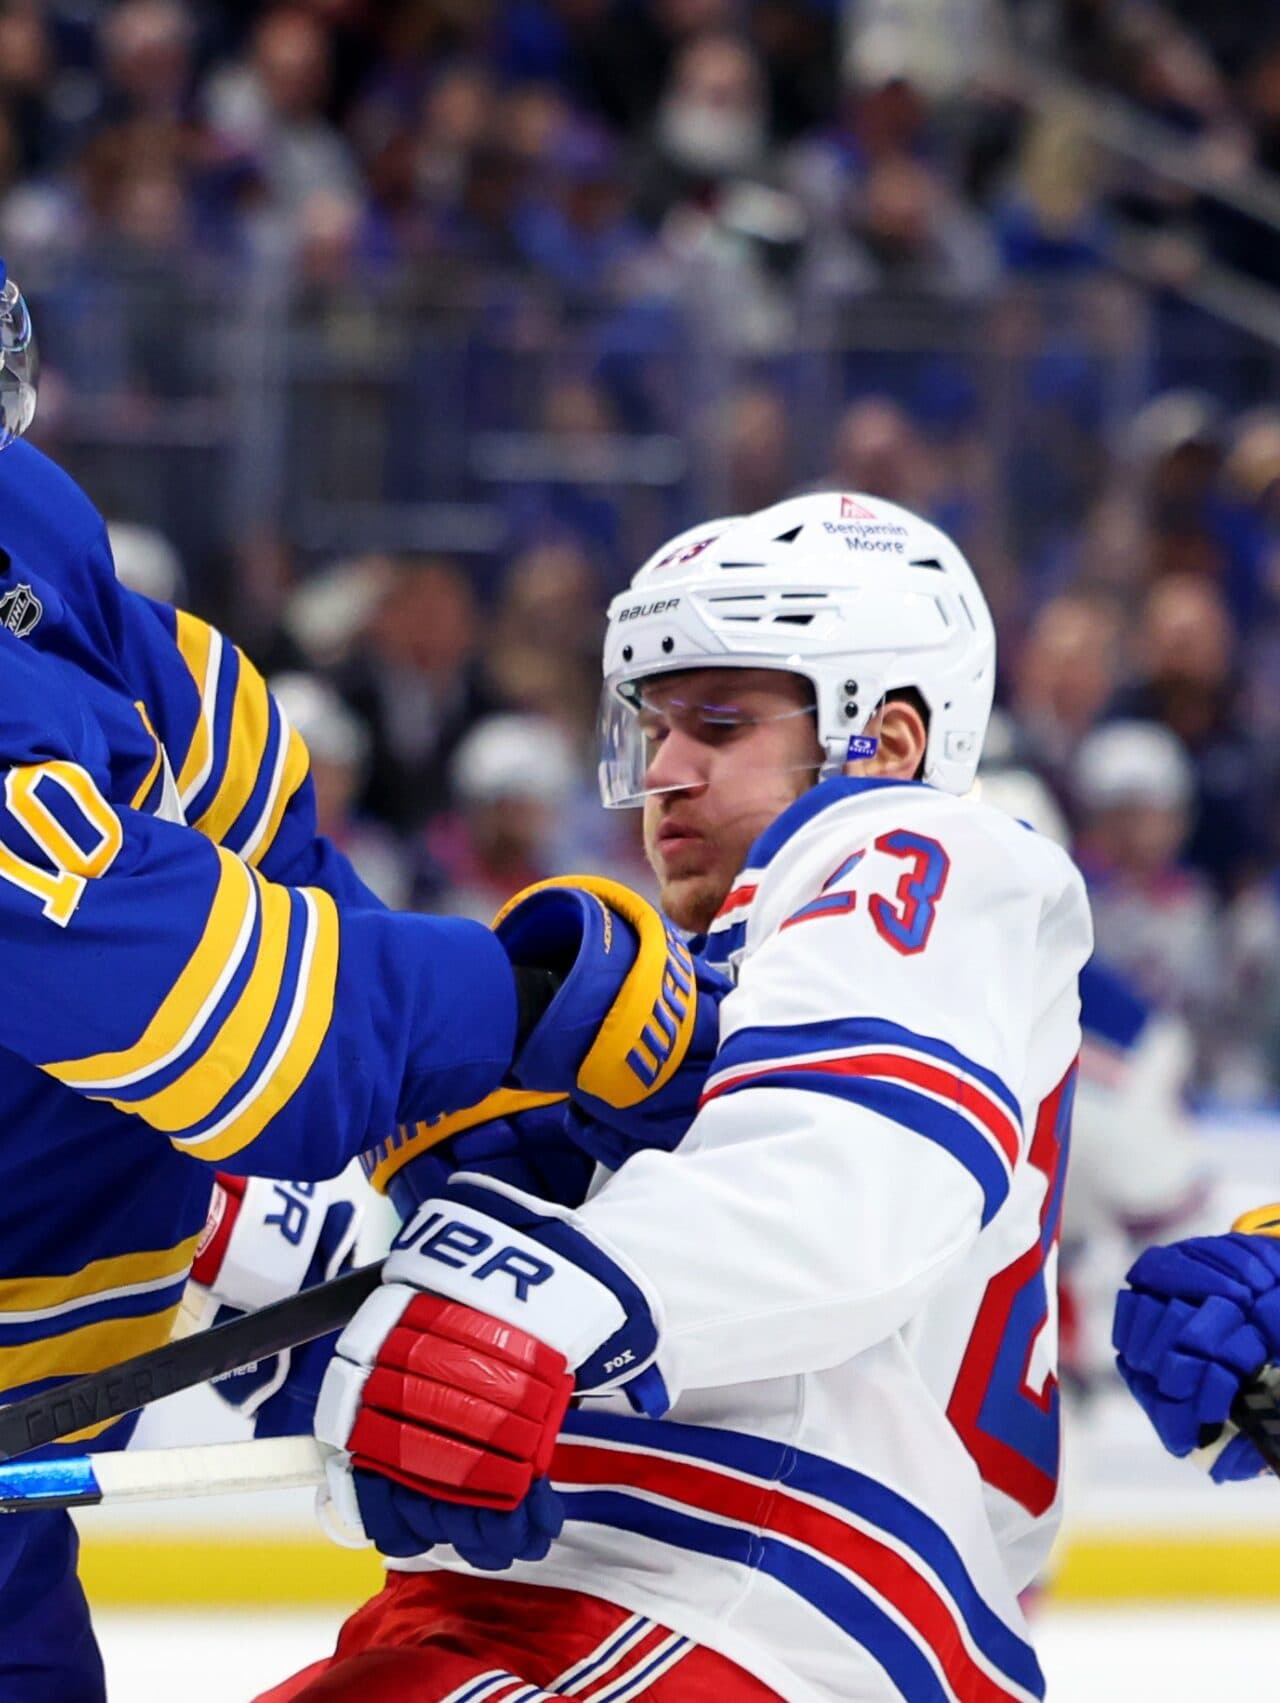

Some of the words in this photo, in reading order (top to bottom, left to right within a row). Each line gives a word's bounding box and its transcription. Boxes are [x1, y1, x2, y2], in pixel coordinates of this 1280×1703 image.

[822, 521, 909, 538] Benjamin
[845, 537, 905, 554] Moore
[602, 1349, 637, 1374] FOX
